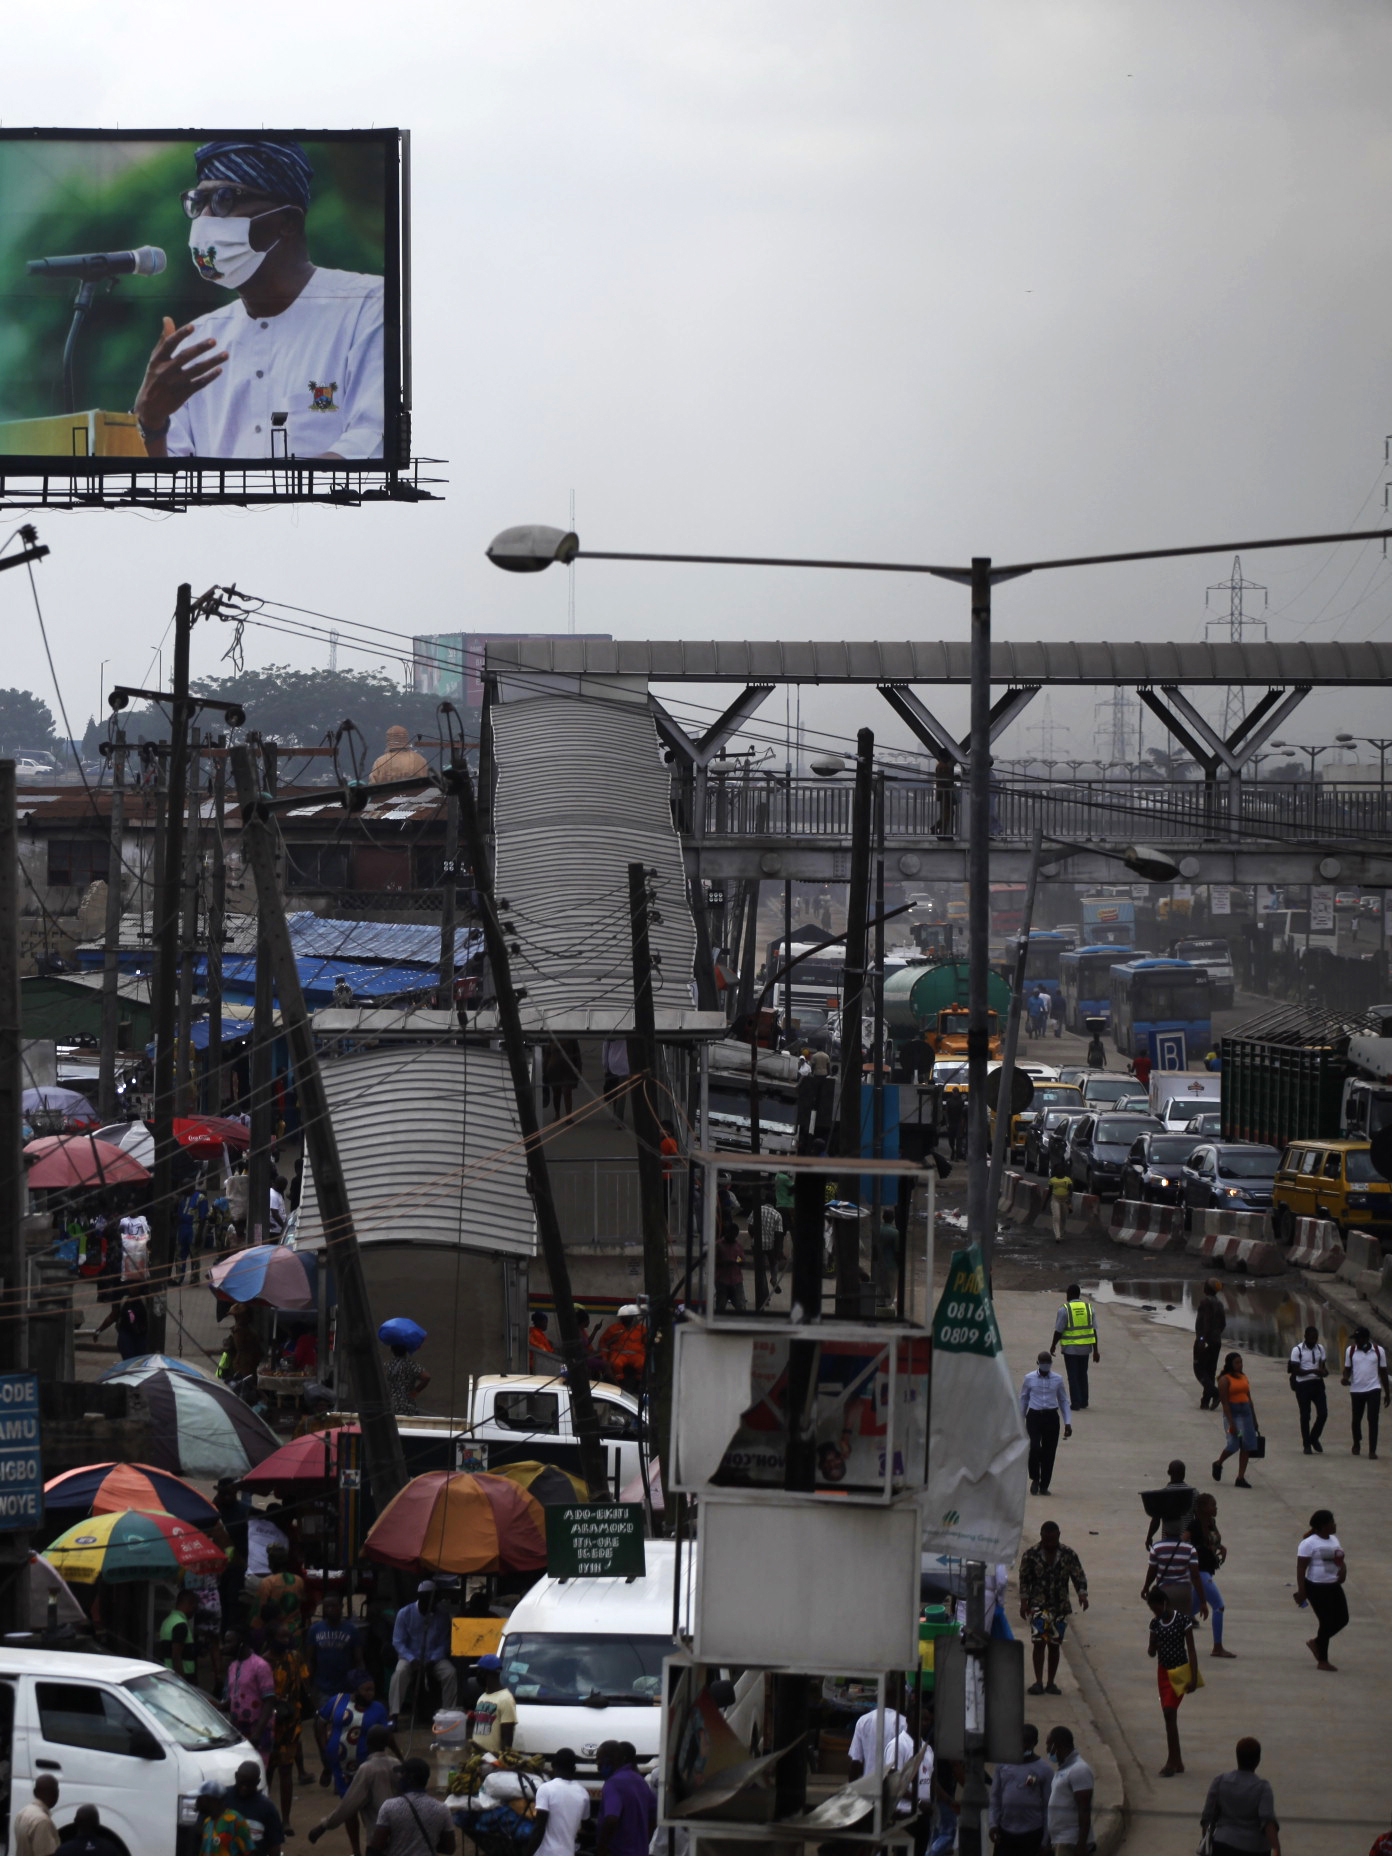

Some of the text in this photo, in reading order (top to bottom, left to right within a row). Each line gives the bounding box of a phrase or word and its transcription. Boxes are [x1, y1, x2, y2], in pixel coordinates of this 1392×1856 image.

[948, 1301, 985, 1321] 0816
[941, 1326, 979, 1344] 0809
[564, 1509, 628, 1520] ADO-EKITI
